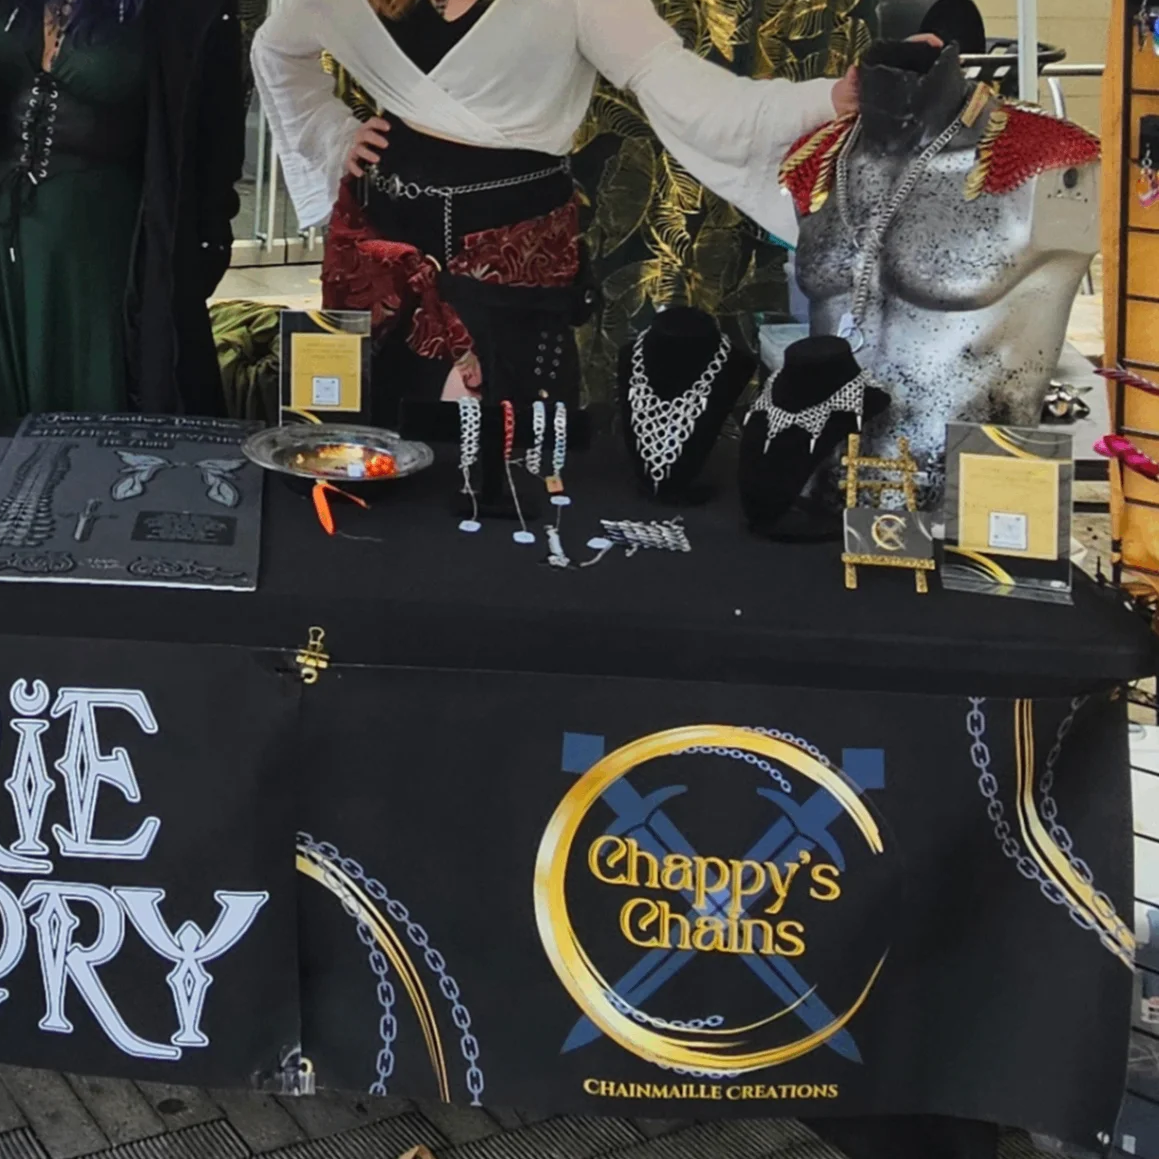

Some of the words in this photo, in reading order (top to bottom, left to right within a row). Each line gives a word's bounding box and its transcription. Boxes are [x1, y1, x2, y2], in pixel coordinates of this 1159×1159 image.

[587, 834, 841, 915] Chappy's
[619, 897, 806, 957] Chains
[583, 1078, 722, 1100] CHAINMAILLE
[725, 1082, 839, 1101] CREATIONS
